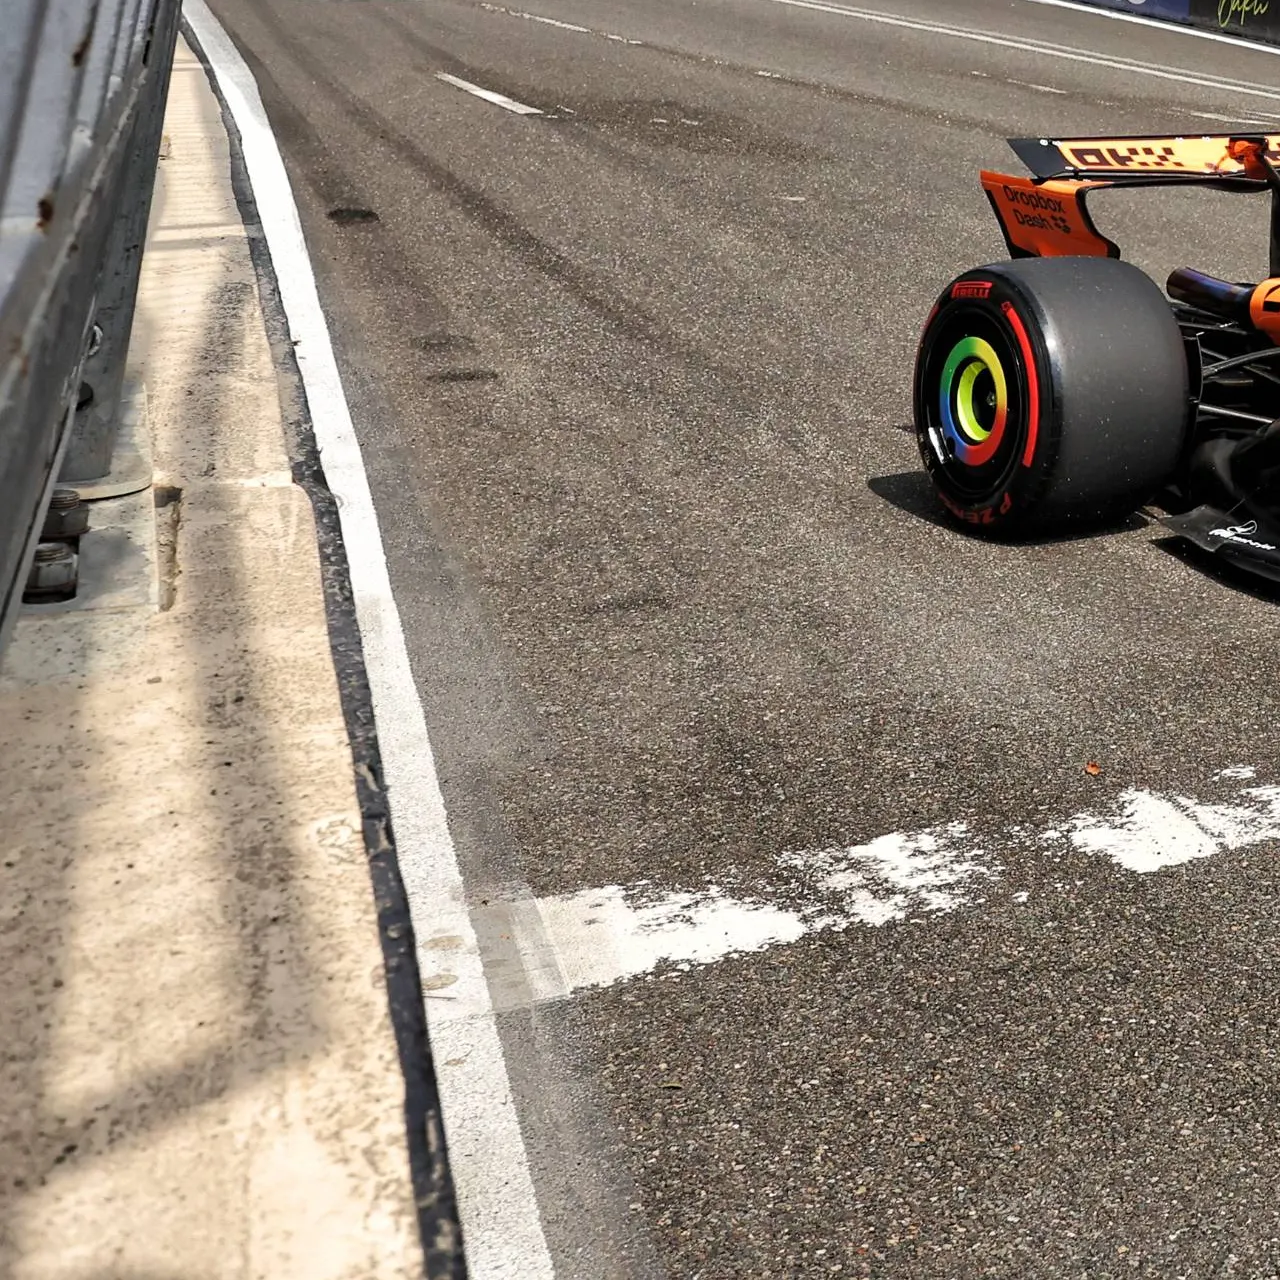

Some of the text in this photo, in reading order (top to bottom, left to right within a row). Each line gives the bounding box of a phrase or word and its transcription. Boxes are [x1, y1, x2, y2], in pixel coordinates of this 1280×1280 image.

[1002, 185, 1066, 214] Dropbox
[1013, 209, 1053, 231] Dash
[952, 281, 993, 299] PIRELLI
